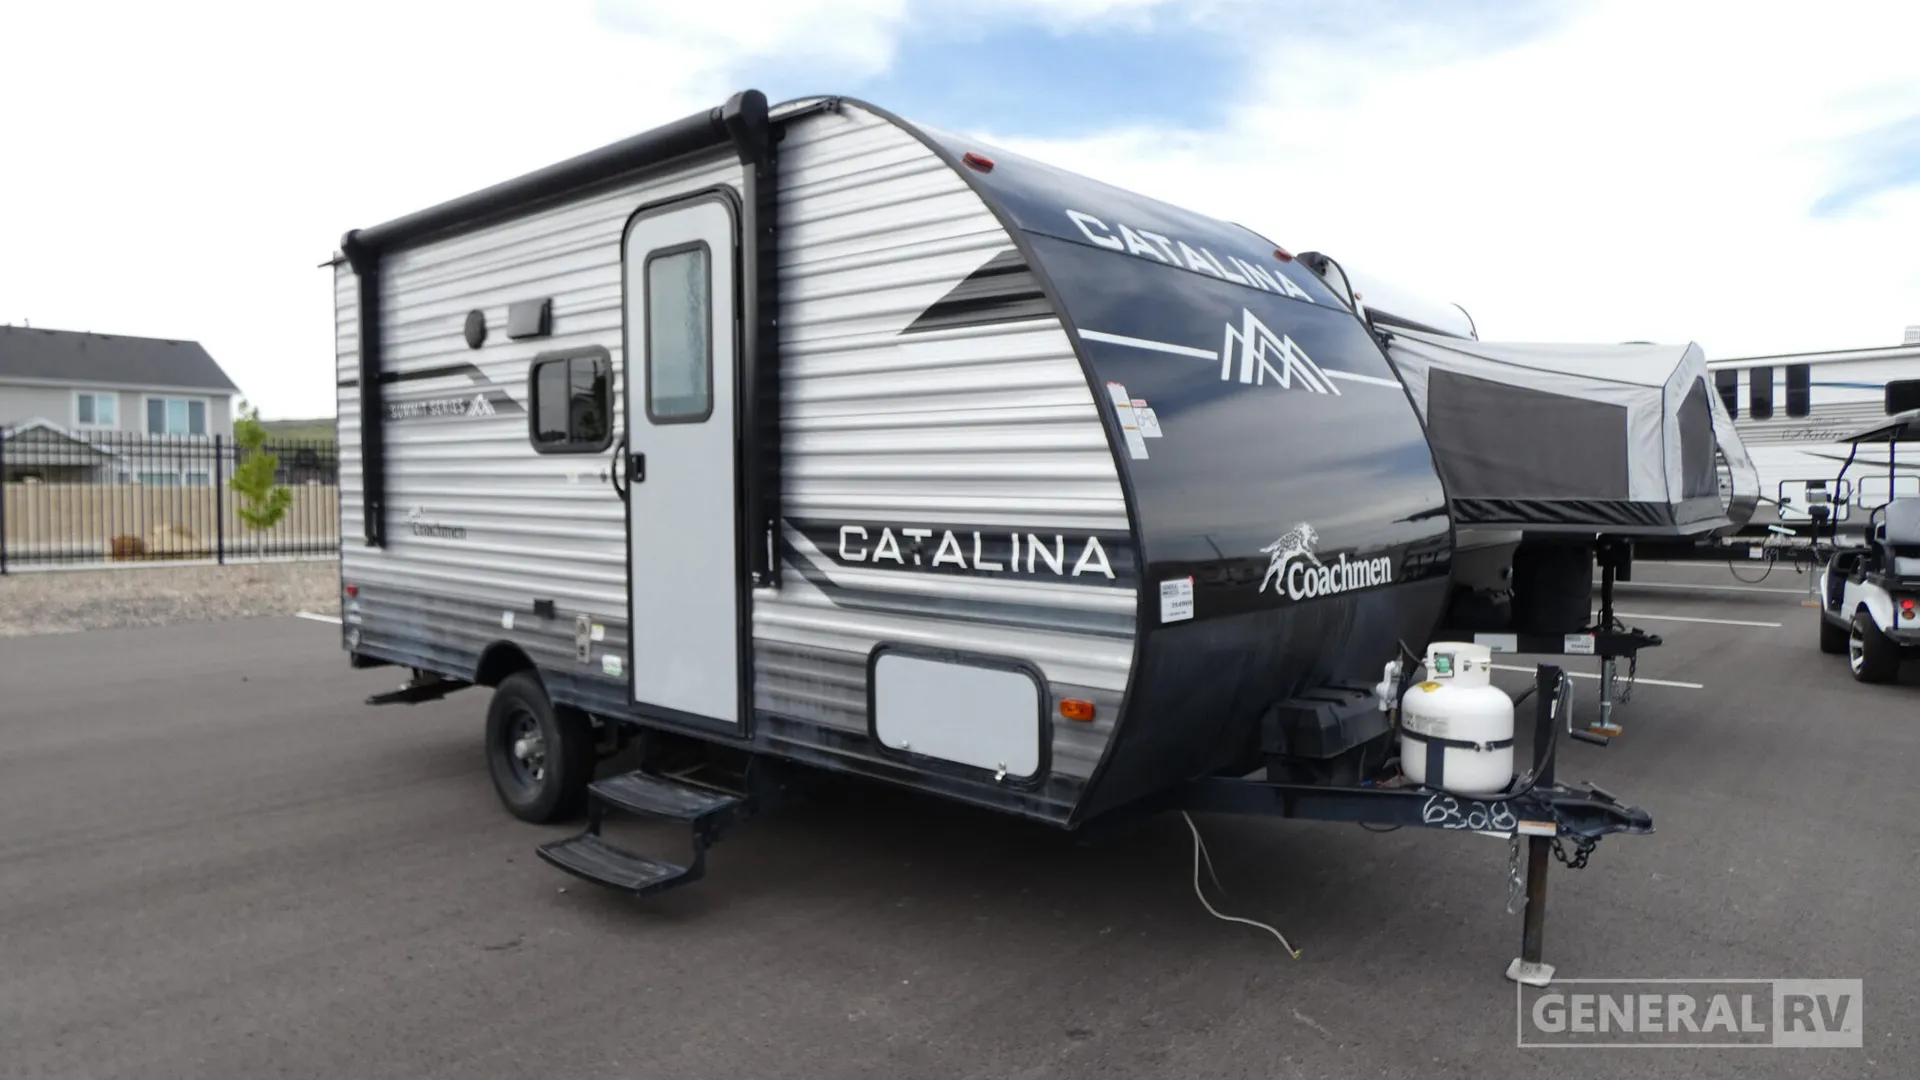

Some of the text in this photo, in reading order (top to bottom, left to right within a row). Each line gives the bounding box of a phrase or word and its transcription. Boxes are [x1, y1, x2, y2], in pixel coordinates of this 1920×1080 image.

[1066, 209, 1315, 302] CATALINA
[389, 398, 465, 419] SUMMIT SERIES
[412, 522, 467, 541] Coachmen
[838, 524, 1116, 580] CATALINA
[1287, 552, 1392, 601] Coachmen
